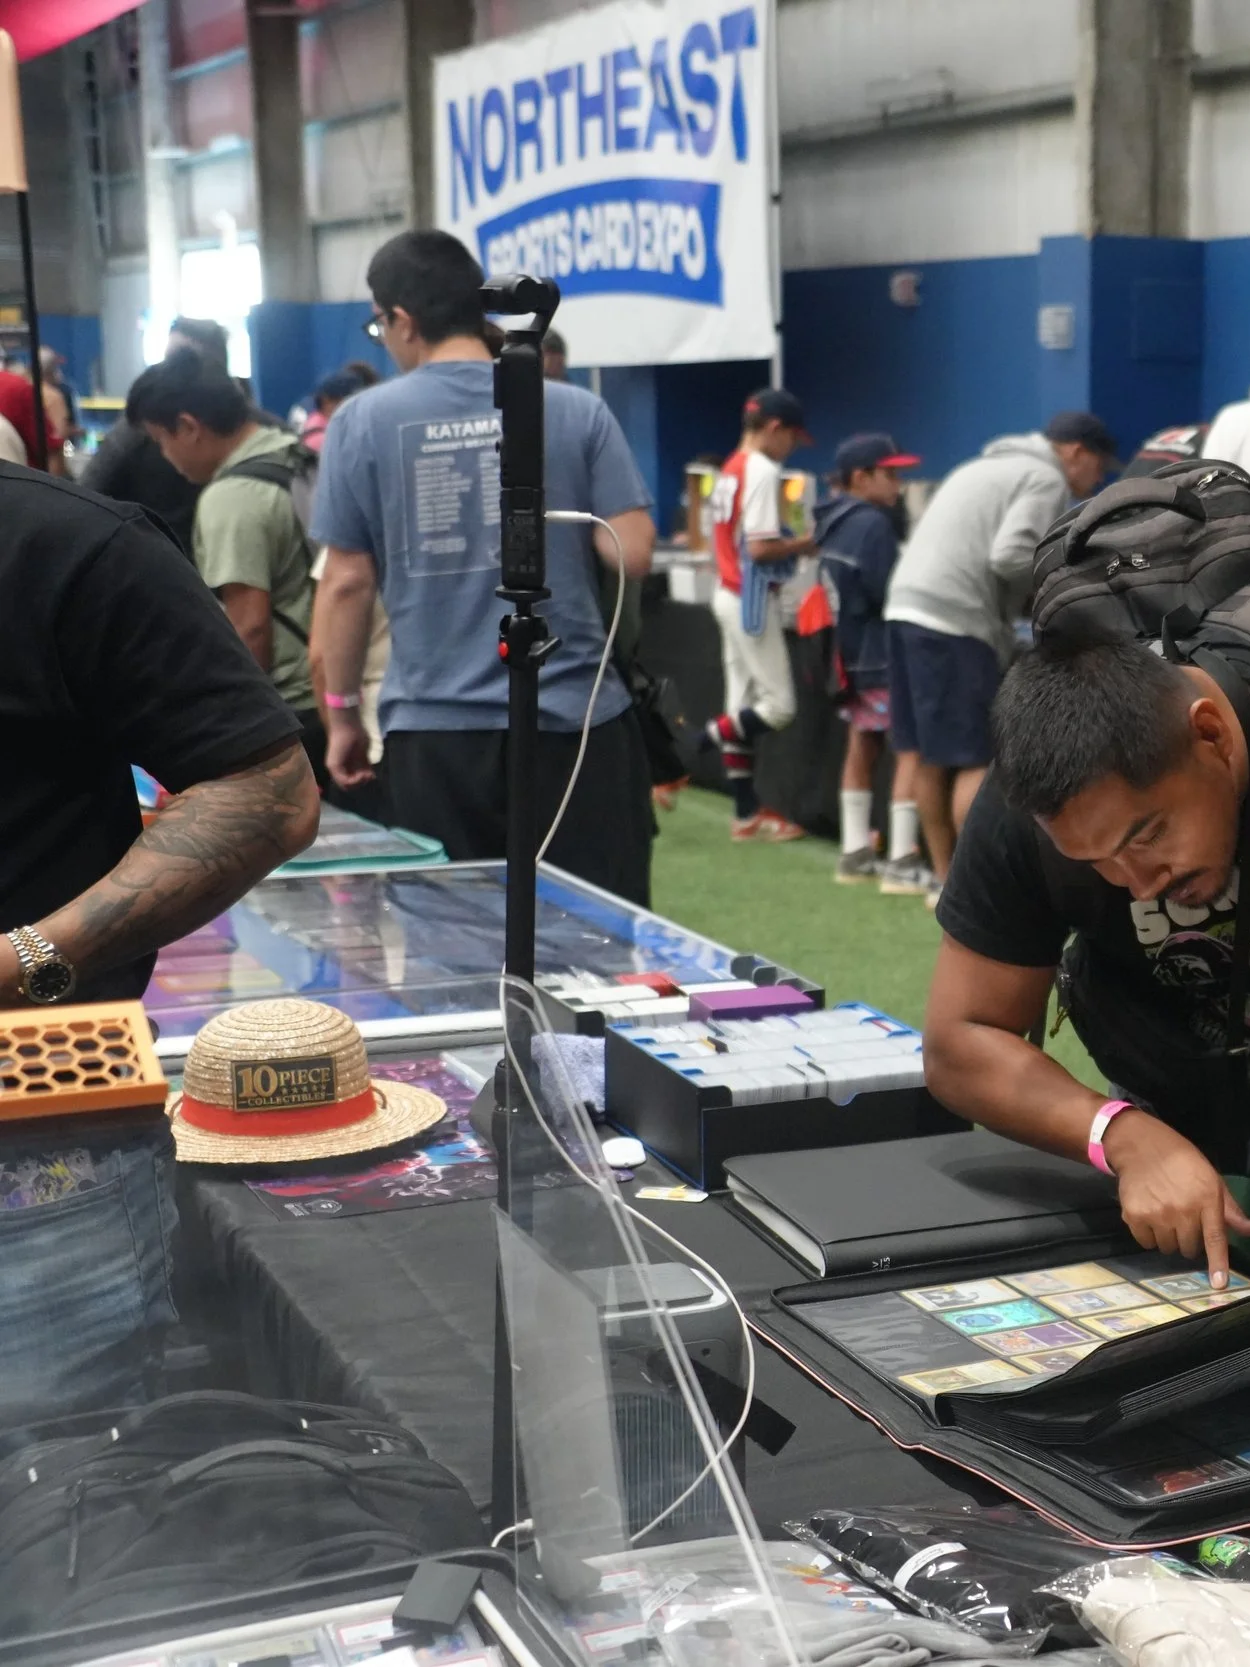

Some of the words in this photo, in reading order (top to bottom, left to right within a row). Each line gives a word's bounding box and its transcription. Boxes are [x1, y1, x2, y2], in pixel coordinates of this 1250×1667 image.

[448, 6, 757, 223] NORTHEAST
[487, 208, 573, 280] SPORTS
[573, 201, 636, 274] CARD
[635, 200, 706, 281] EXPO
[237, 1065, 278, 1098] 10
[278, 1067, 331, 1086] PIECE
[247, 1091, 326, 1106] COLLECTIBLES
